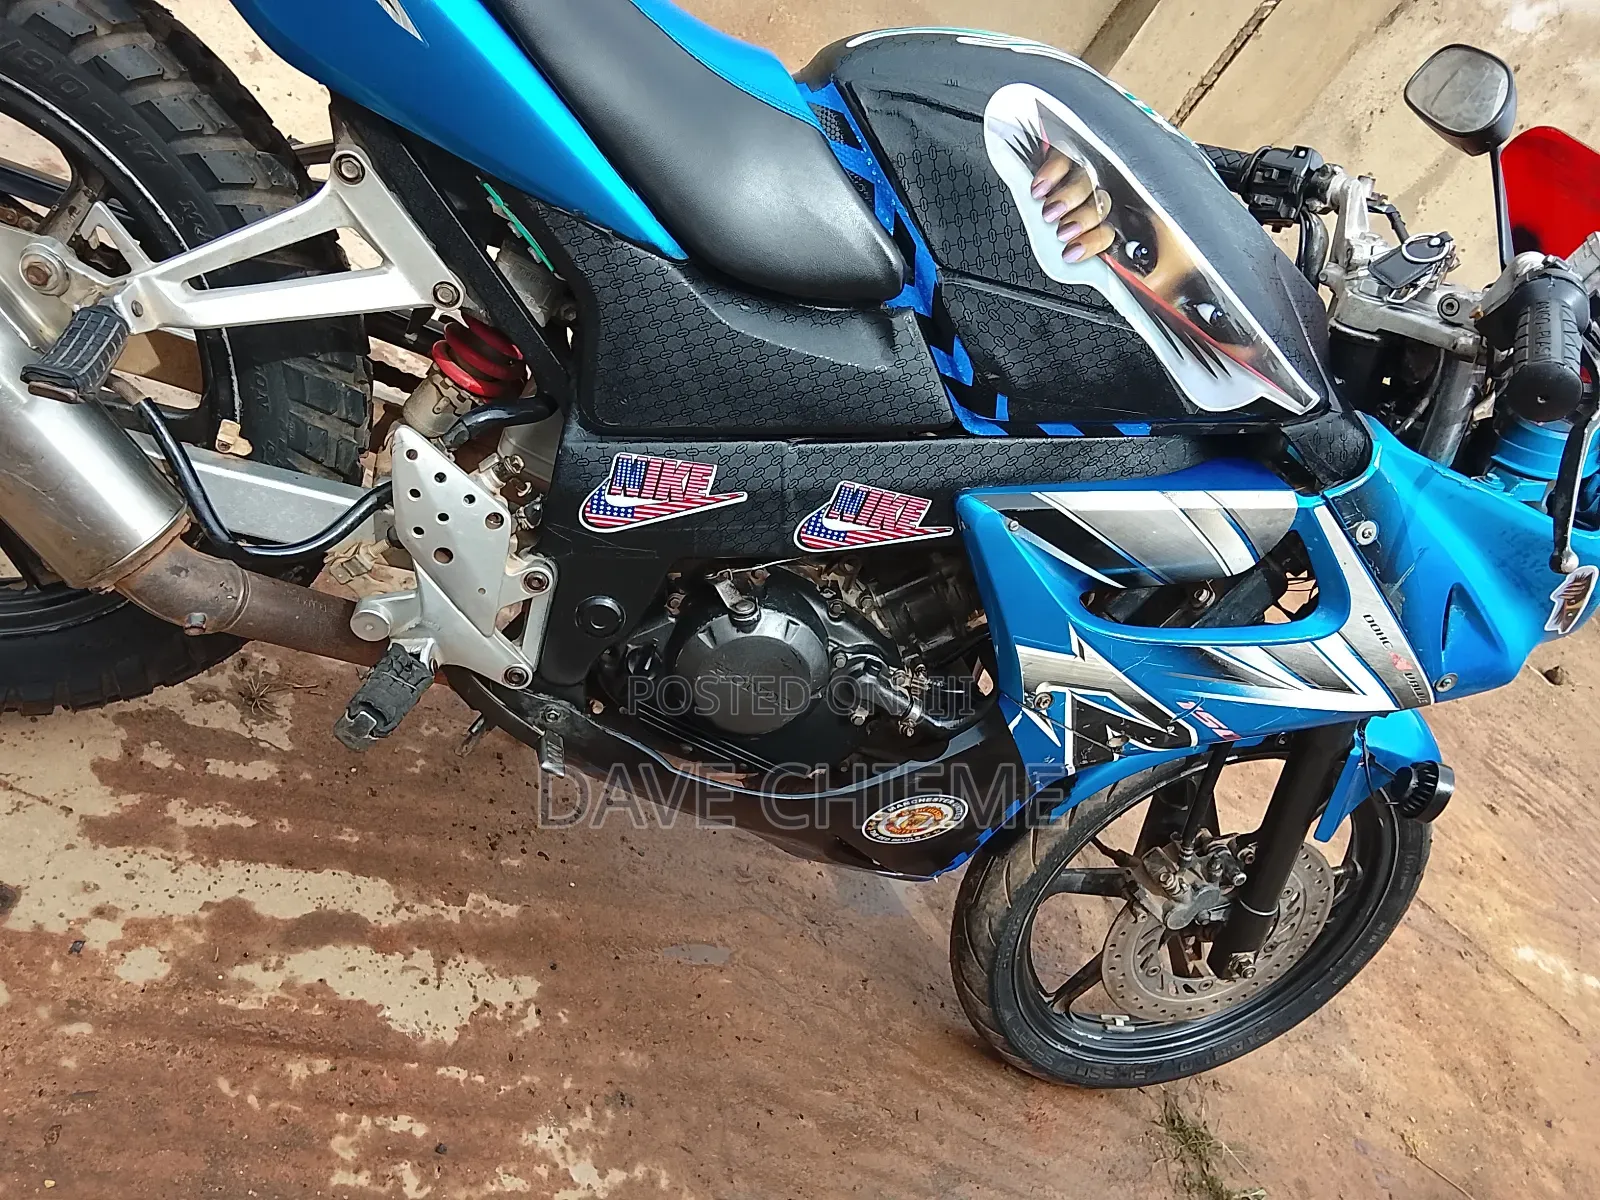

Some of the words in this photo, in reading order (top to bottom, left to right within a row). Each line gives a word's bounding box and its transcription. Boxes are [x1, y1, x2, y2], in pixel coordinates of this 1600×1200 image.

[610, 454, 715, 500] NIKE
[828, 483, 931, 531] NIKE
[1362, 614, 1394, 651] DOHC
[887, 796, 955, 813] MANCHESTER
